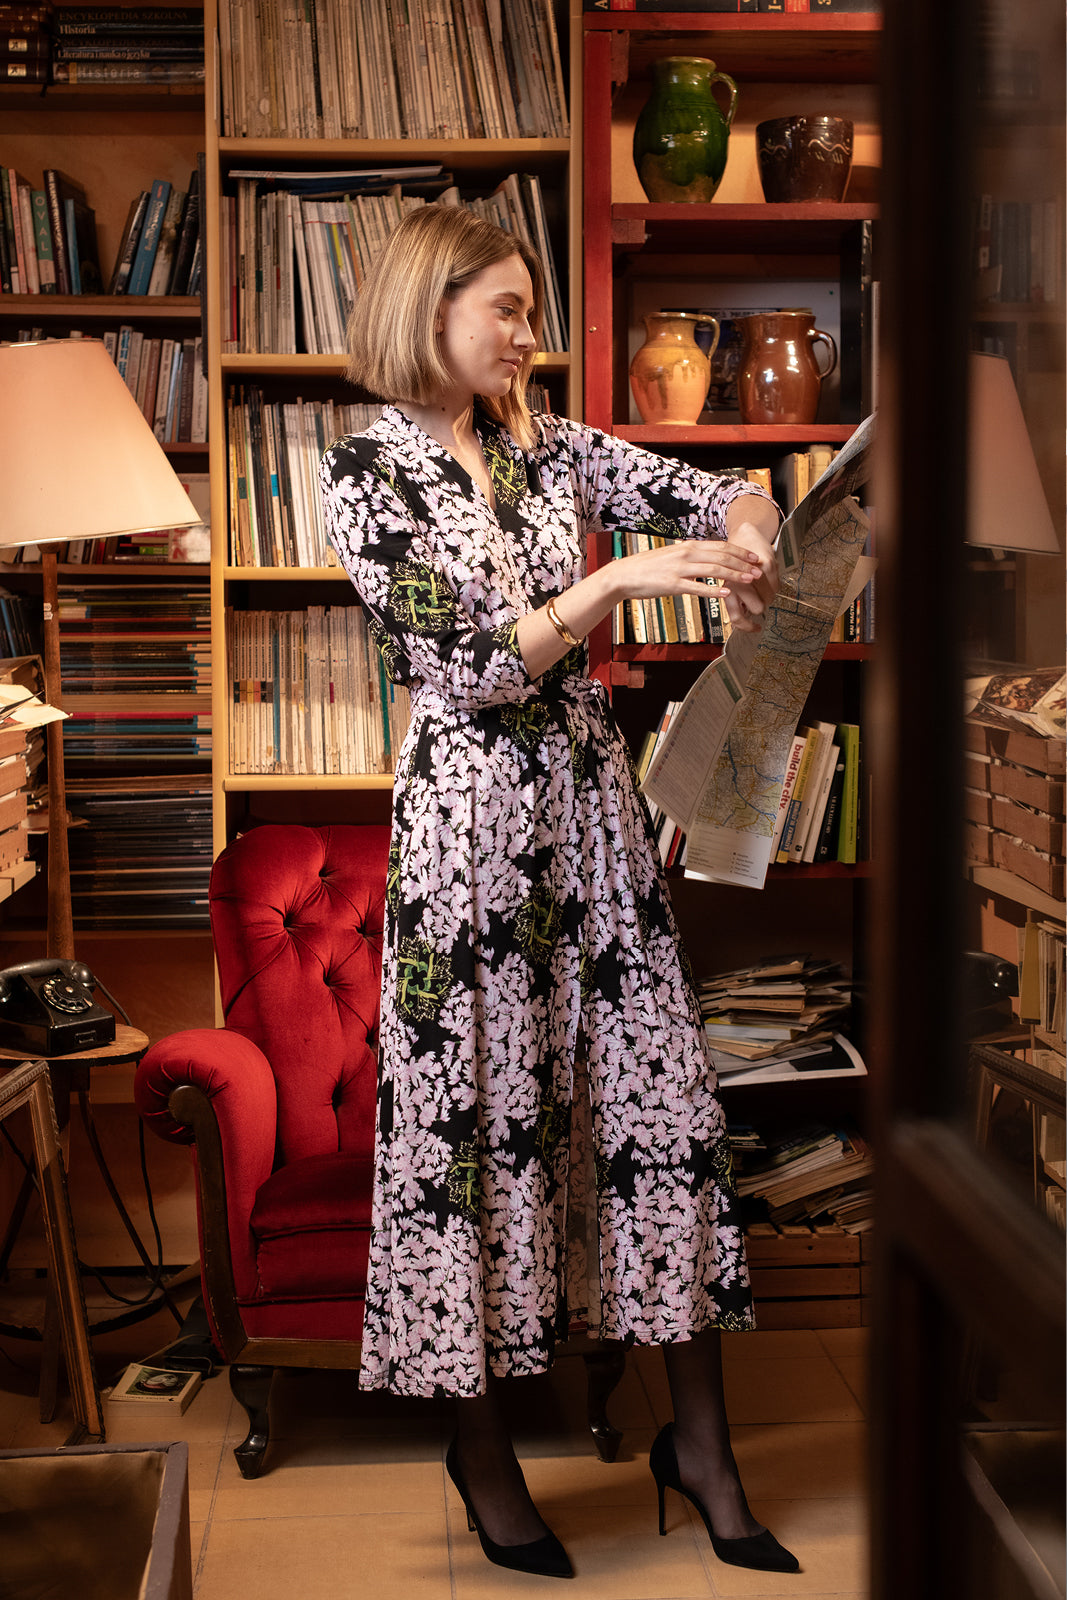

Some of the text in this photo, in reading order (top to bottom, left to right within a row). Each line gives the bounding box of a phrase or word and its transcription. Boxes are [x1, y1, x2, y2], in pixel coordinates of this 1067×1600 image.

[60, 24, 96, 34] Historia
[77, 66, 141, 79] Historia
[35, 196, 49, 252] OVAL
[789, 744, 804, 771] build
[784, 771, 796, 788] the
[779, 789, 791, 810] city.
